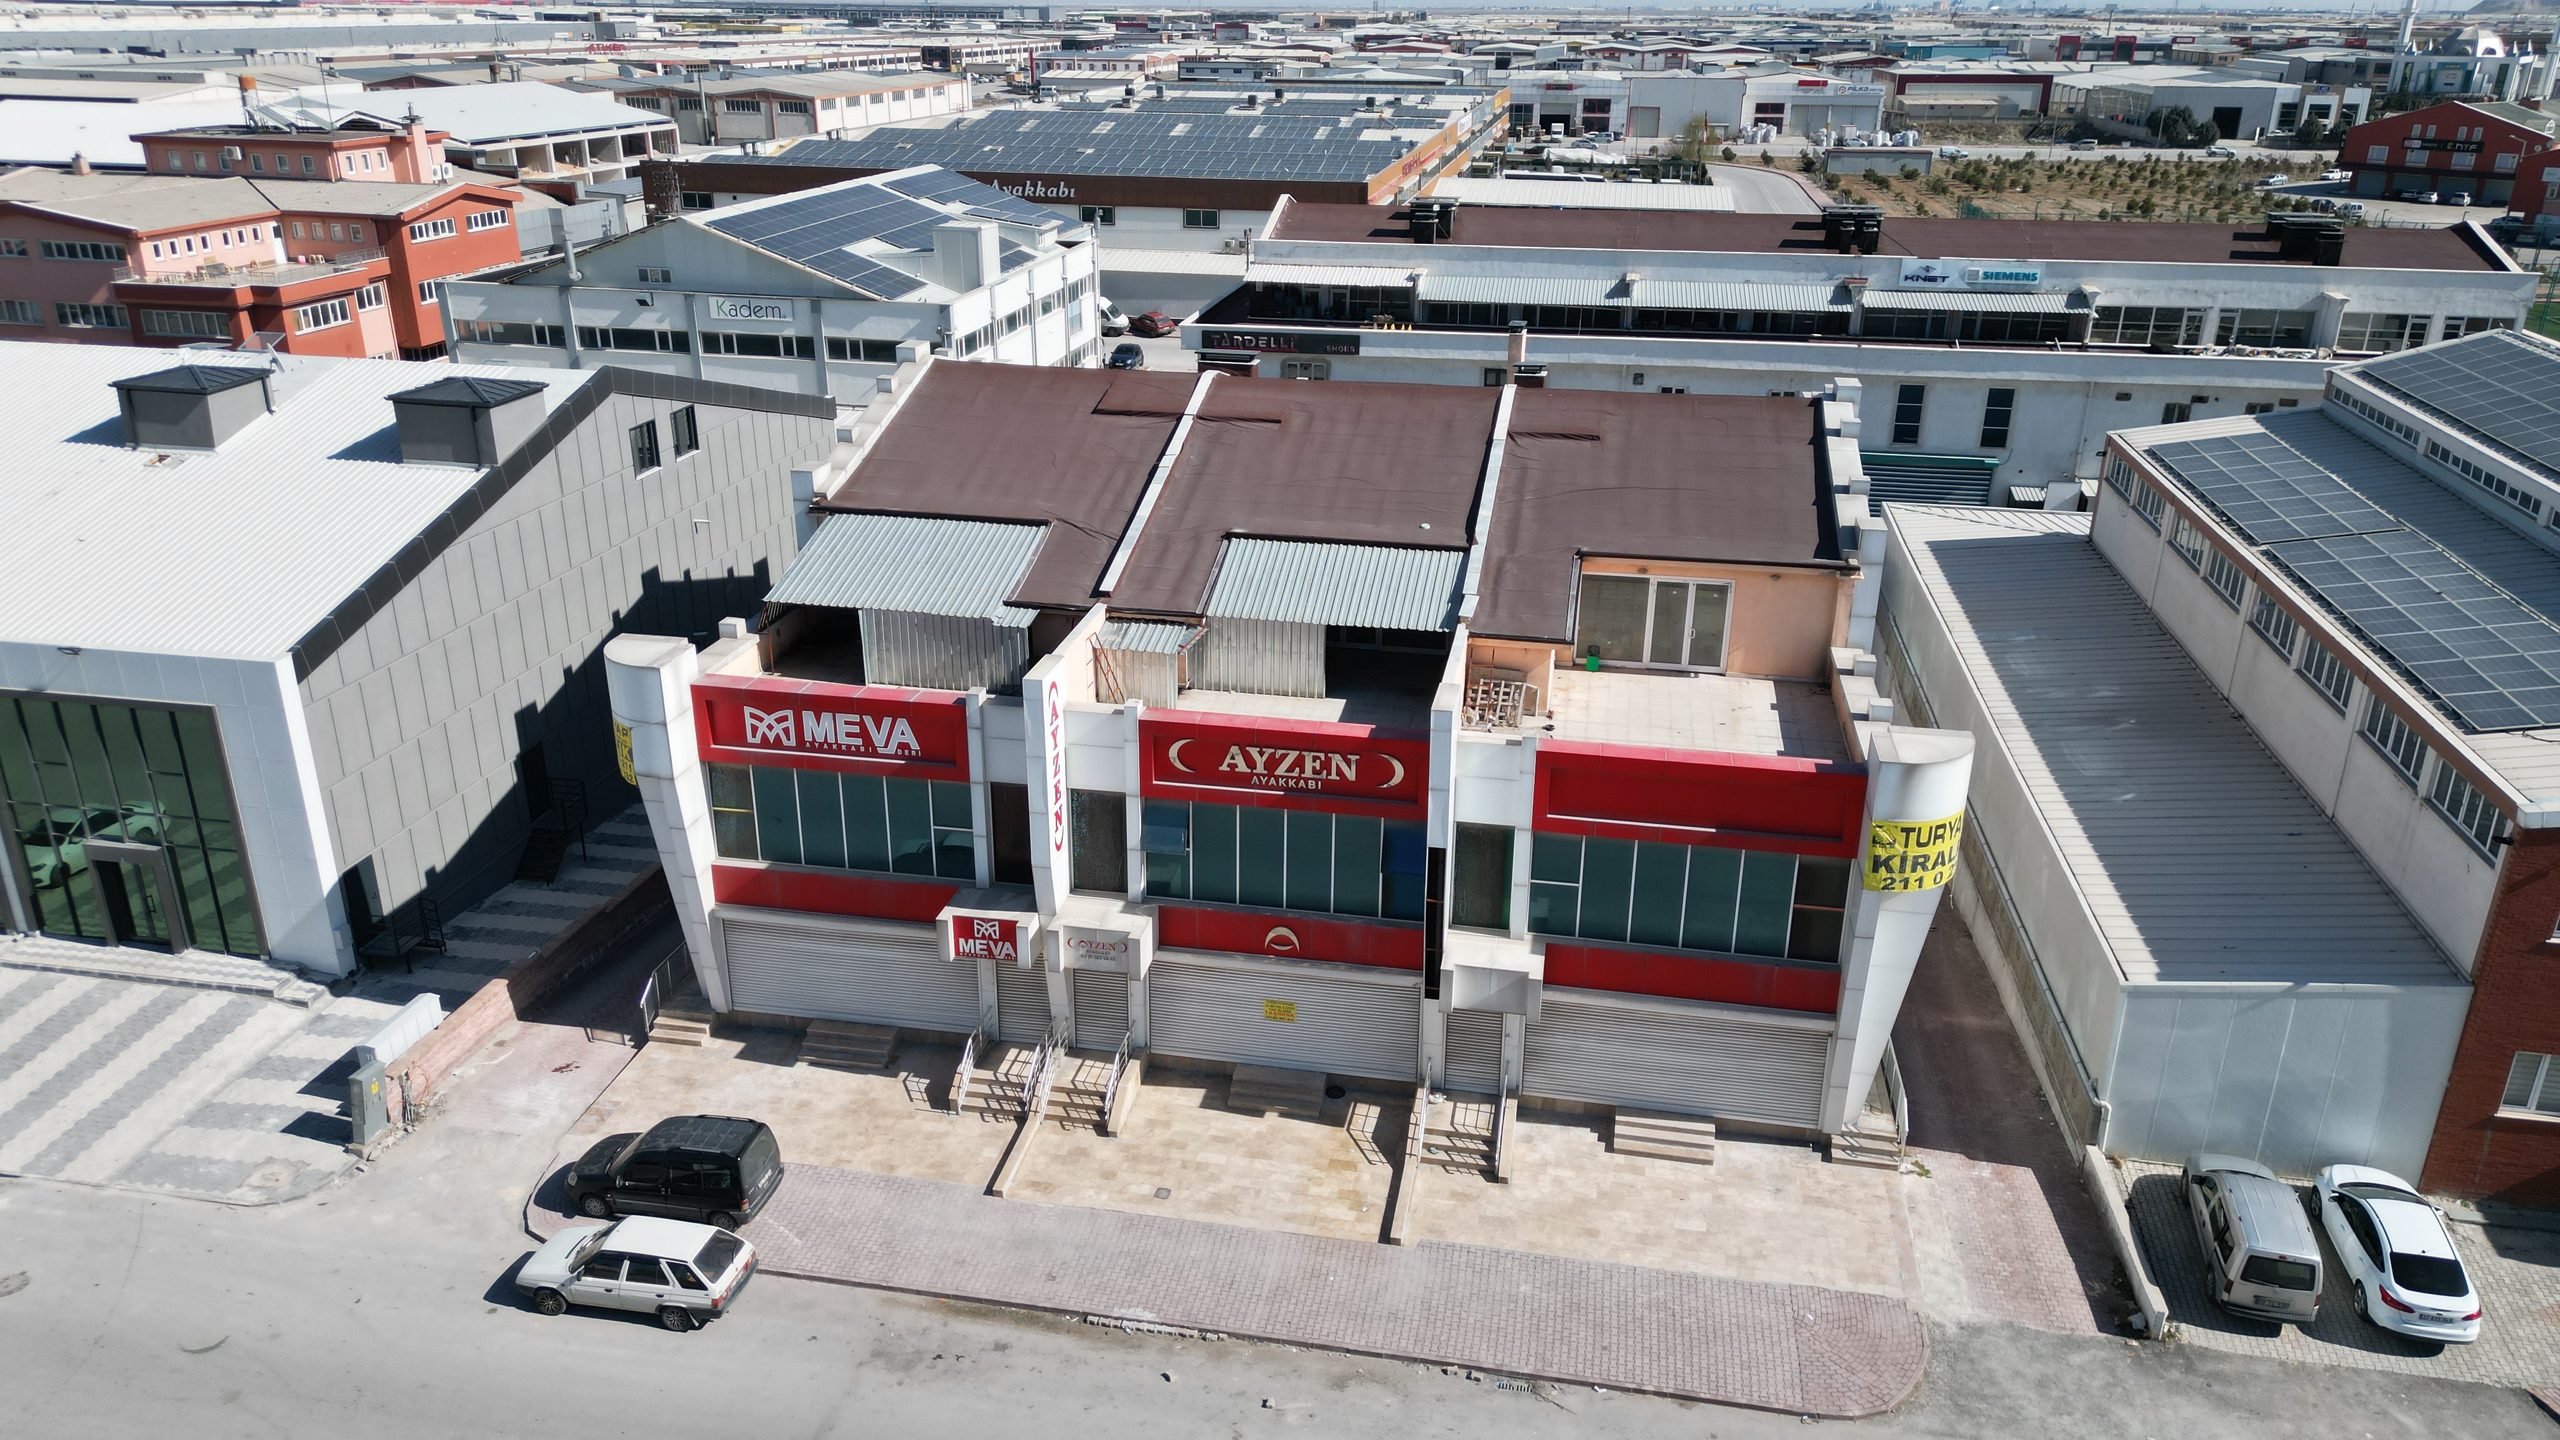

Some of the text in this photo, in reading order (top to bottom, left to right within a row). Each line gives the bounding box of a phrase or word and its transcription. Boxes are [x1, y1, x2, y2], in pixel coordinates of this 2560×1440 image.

[1904, 274, 1950, 283] KNET
[1982, 270, 2039, 282] SIEMENS
[715, 299, 782, 319] Kadem
[802, 710, 920, 754] MEVA
[805, 742, 873, 753] AYAKKABI
[1049, 700, 1064, 834] AYZEN
[1218, 745, 1360, 782] AYZEN
[1251, 775, 1323, 791] AYAKKABI
[1872, 846, 1958, 874] KİRAL
[1881, 876, 1925, 891] 211
[958, 938, 1016, 960] MEVA
